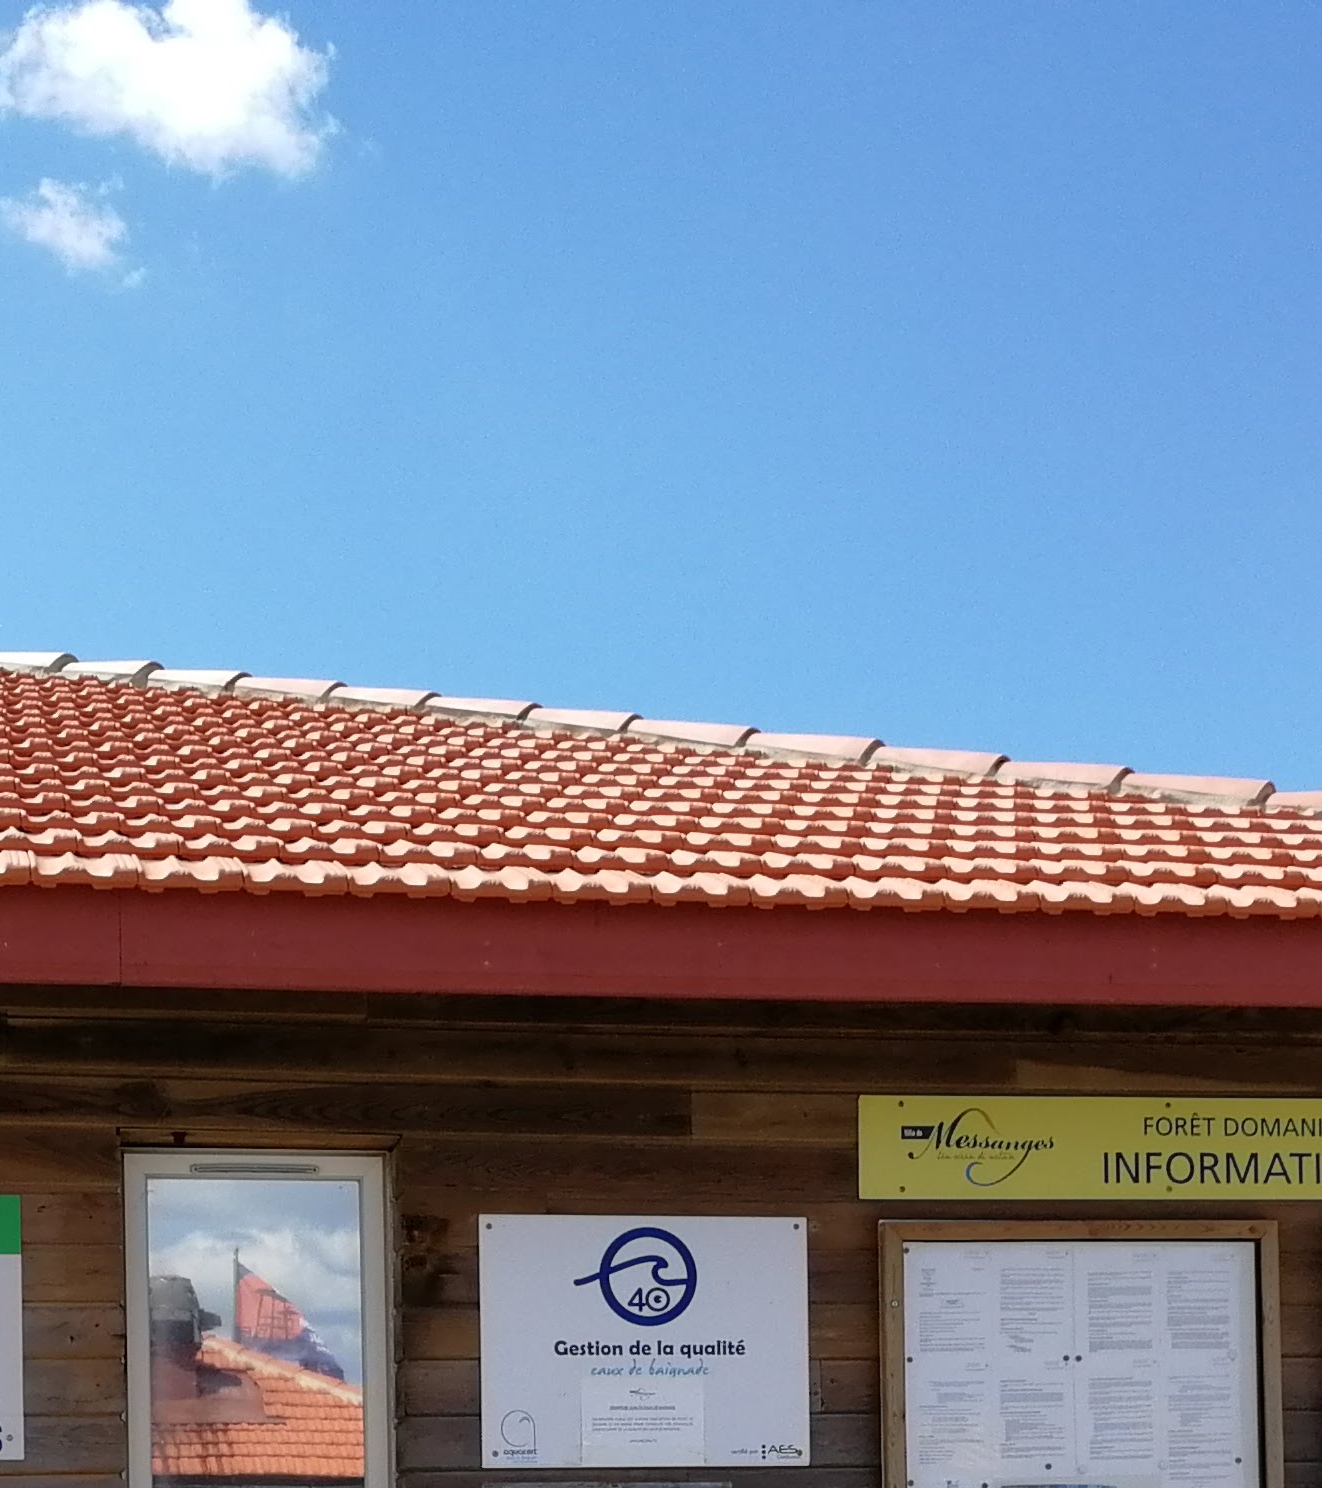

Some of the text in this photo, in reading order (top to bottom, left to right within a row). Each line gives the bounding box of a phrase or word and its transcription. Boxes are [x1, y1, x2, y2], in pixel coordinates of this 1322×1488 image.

[1143, 1112, 1218, 1138] FORÊT
[554, 1339, 746, 1358] Gestion de la qualité
[591, 1358, 710, 1377] eaux de baignade
